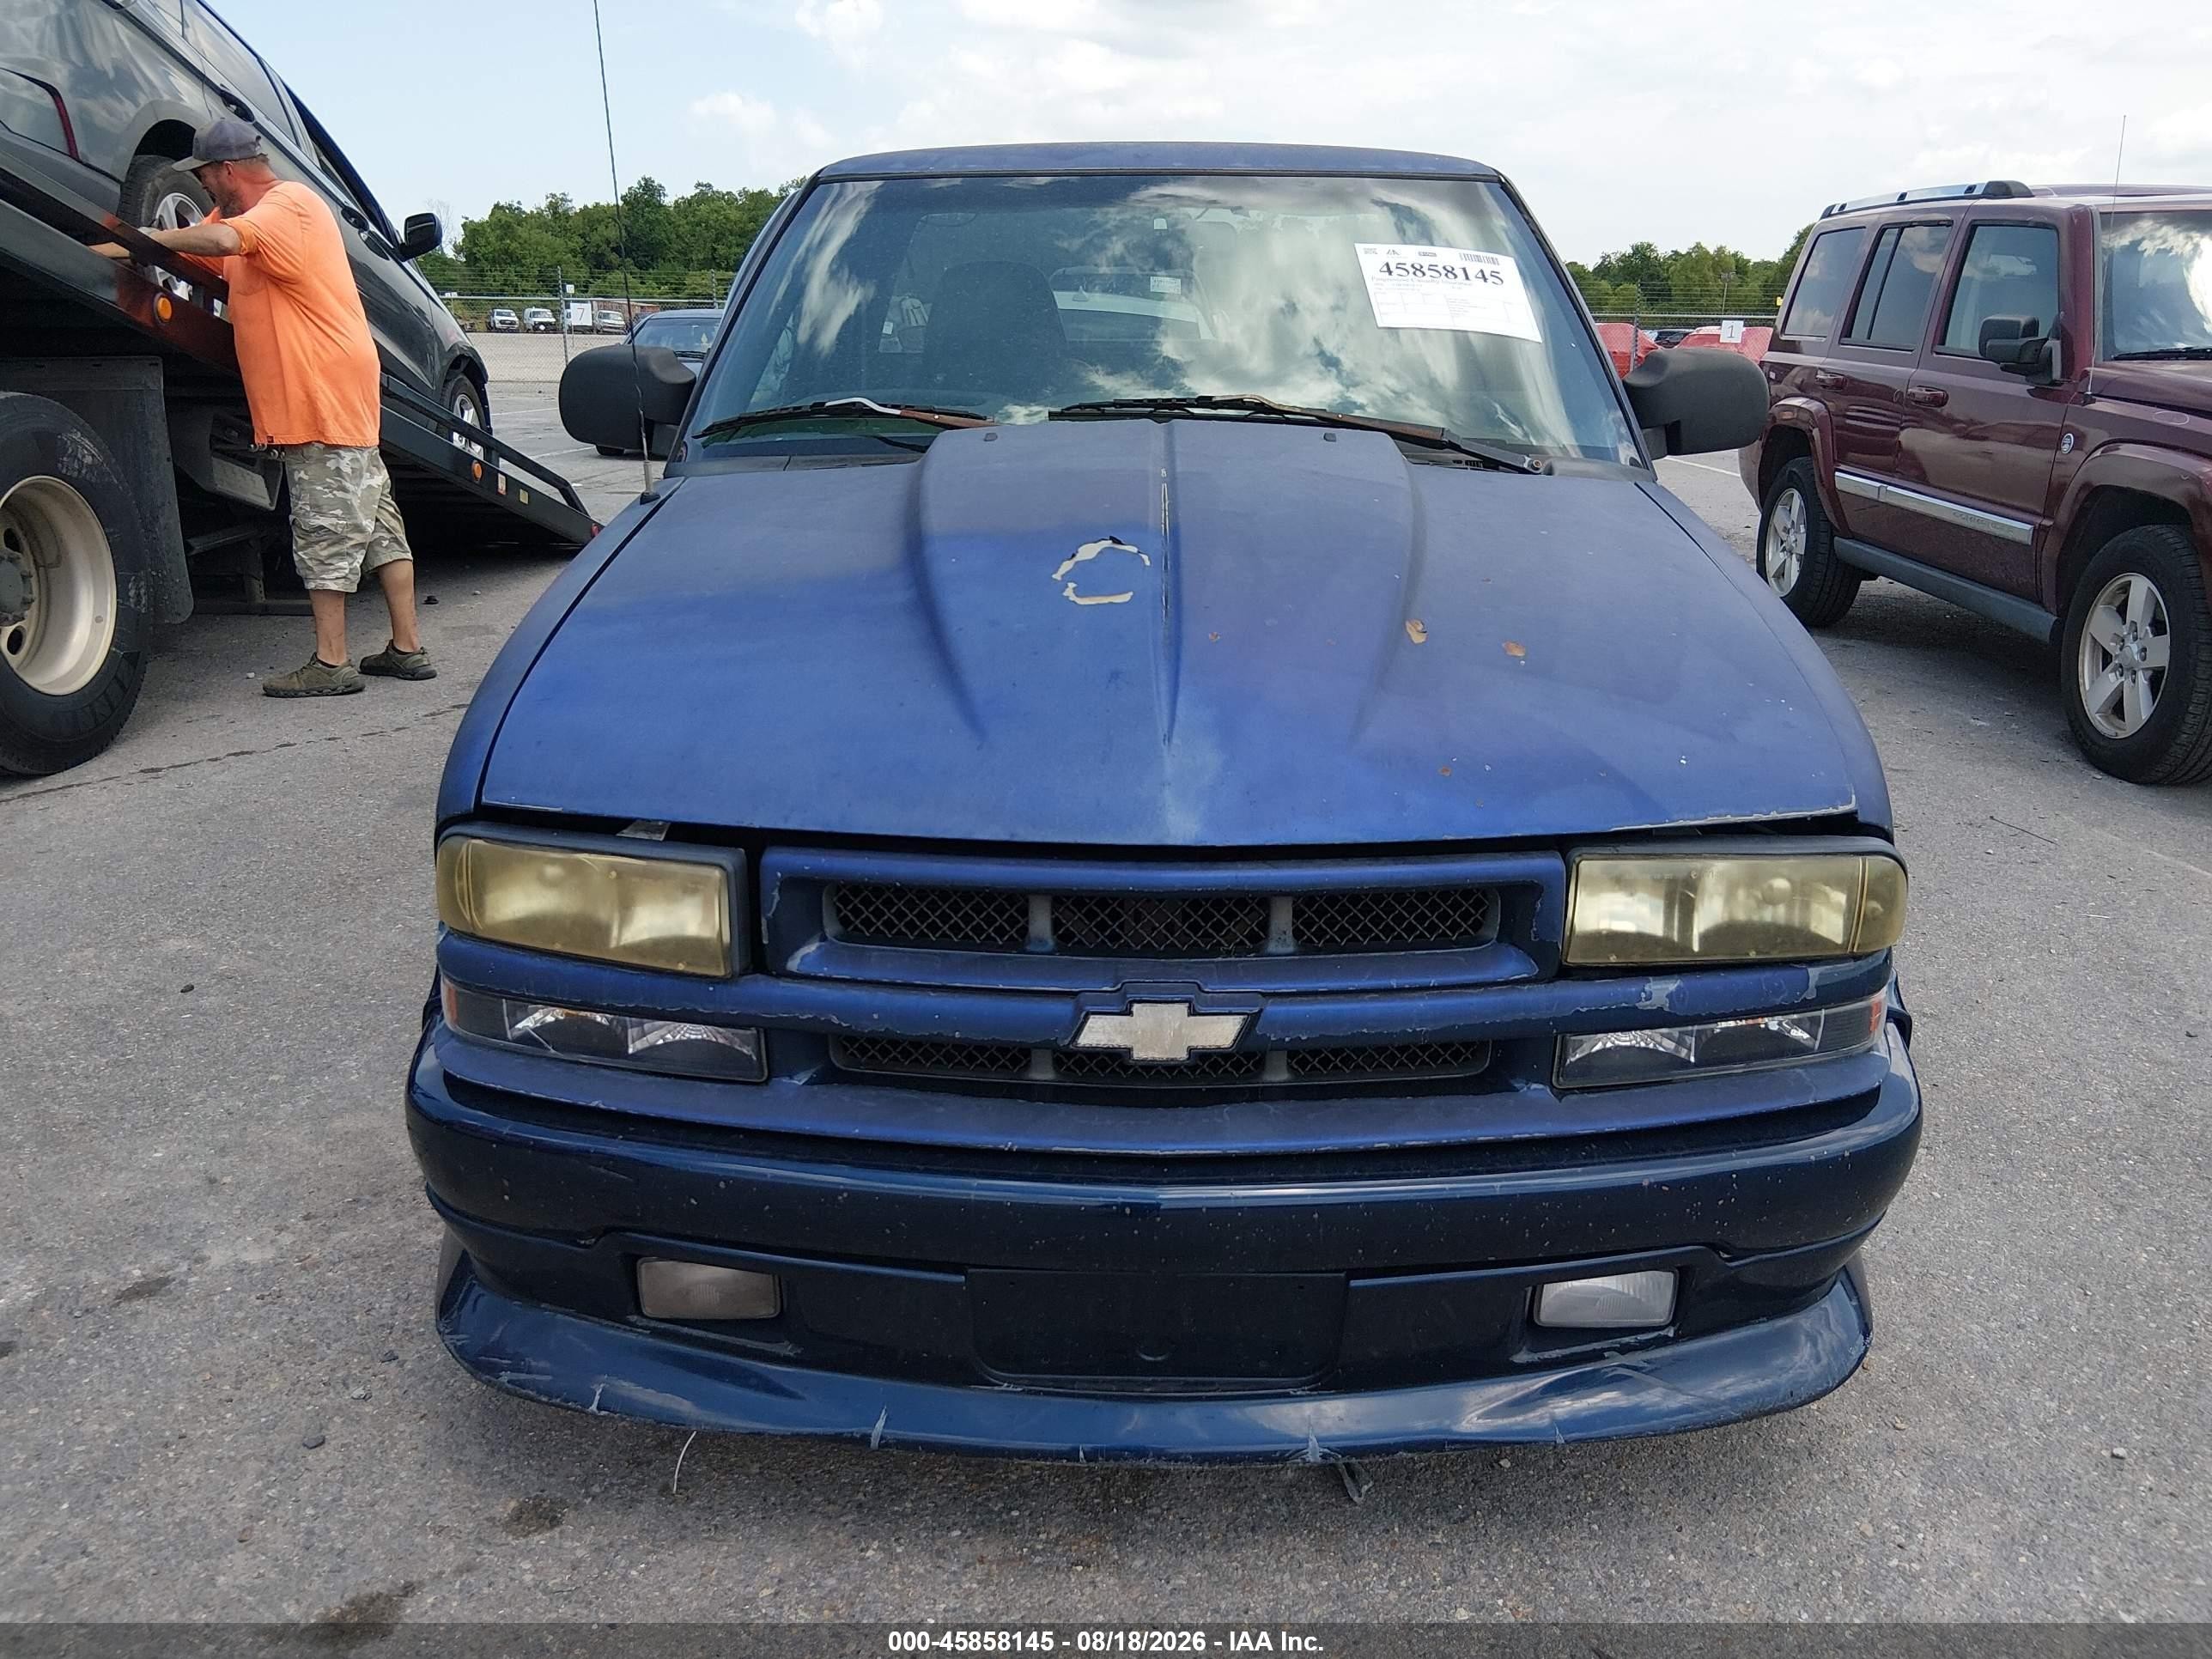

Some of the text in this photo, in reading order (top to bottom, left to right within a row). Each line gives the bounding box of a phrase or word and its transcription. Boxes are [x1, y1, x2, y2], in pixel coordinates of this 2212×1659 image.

[1379, 261, 1504, 286] 45858145
[577, 307, 585, 321] 7
[1727, 325, 1735, 338] 1
